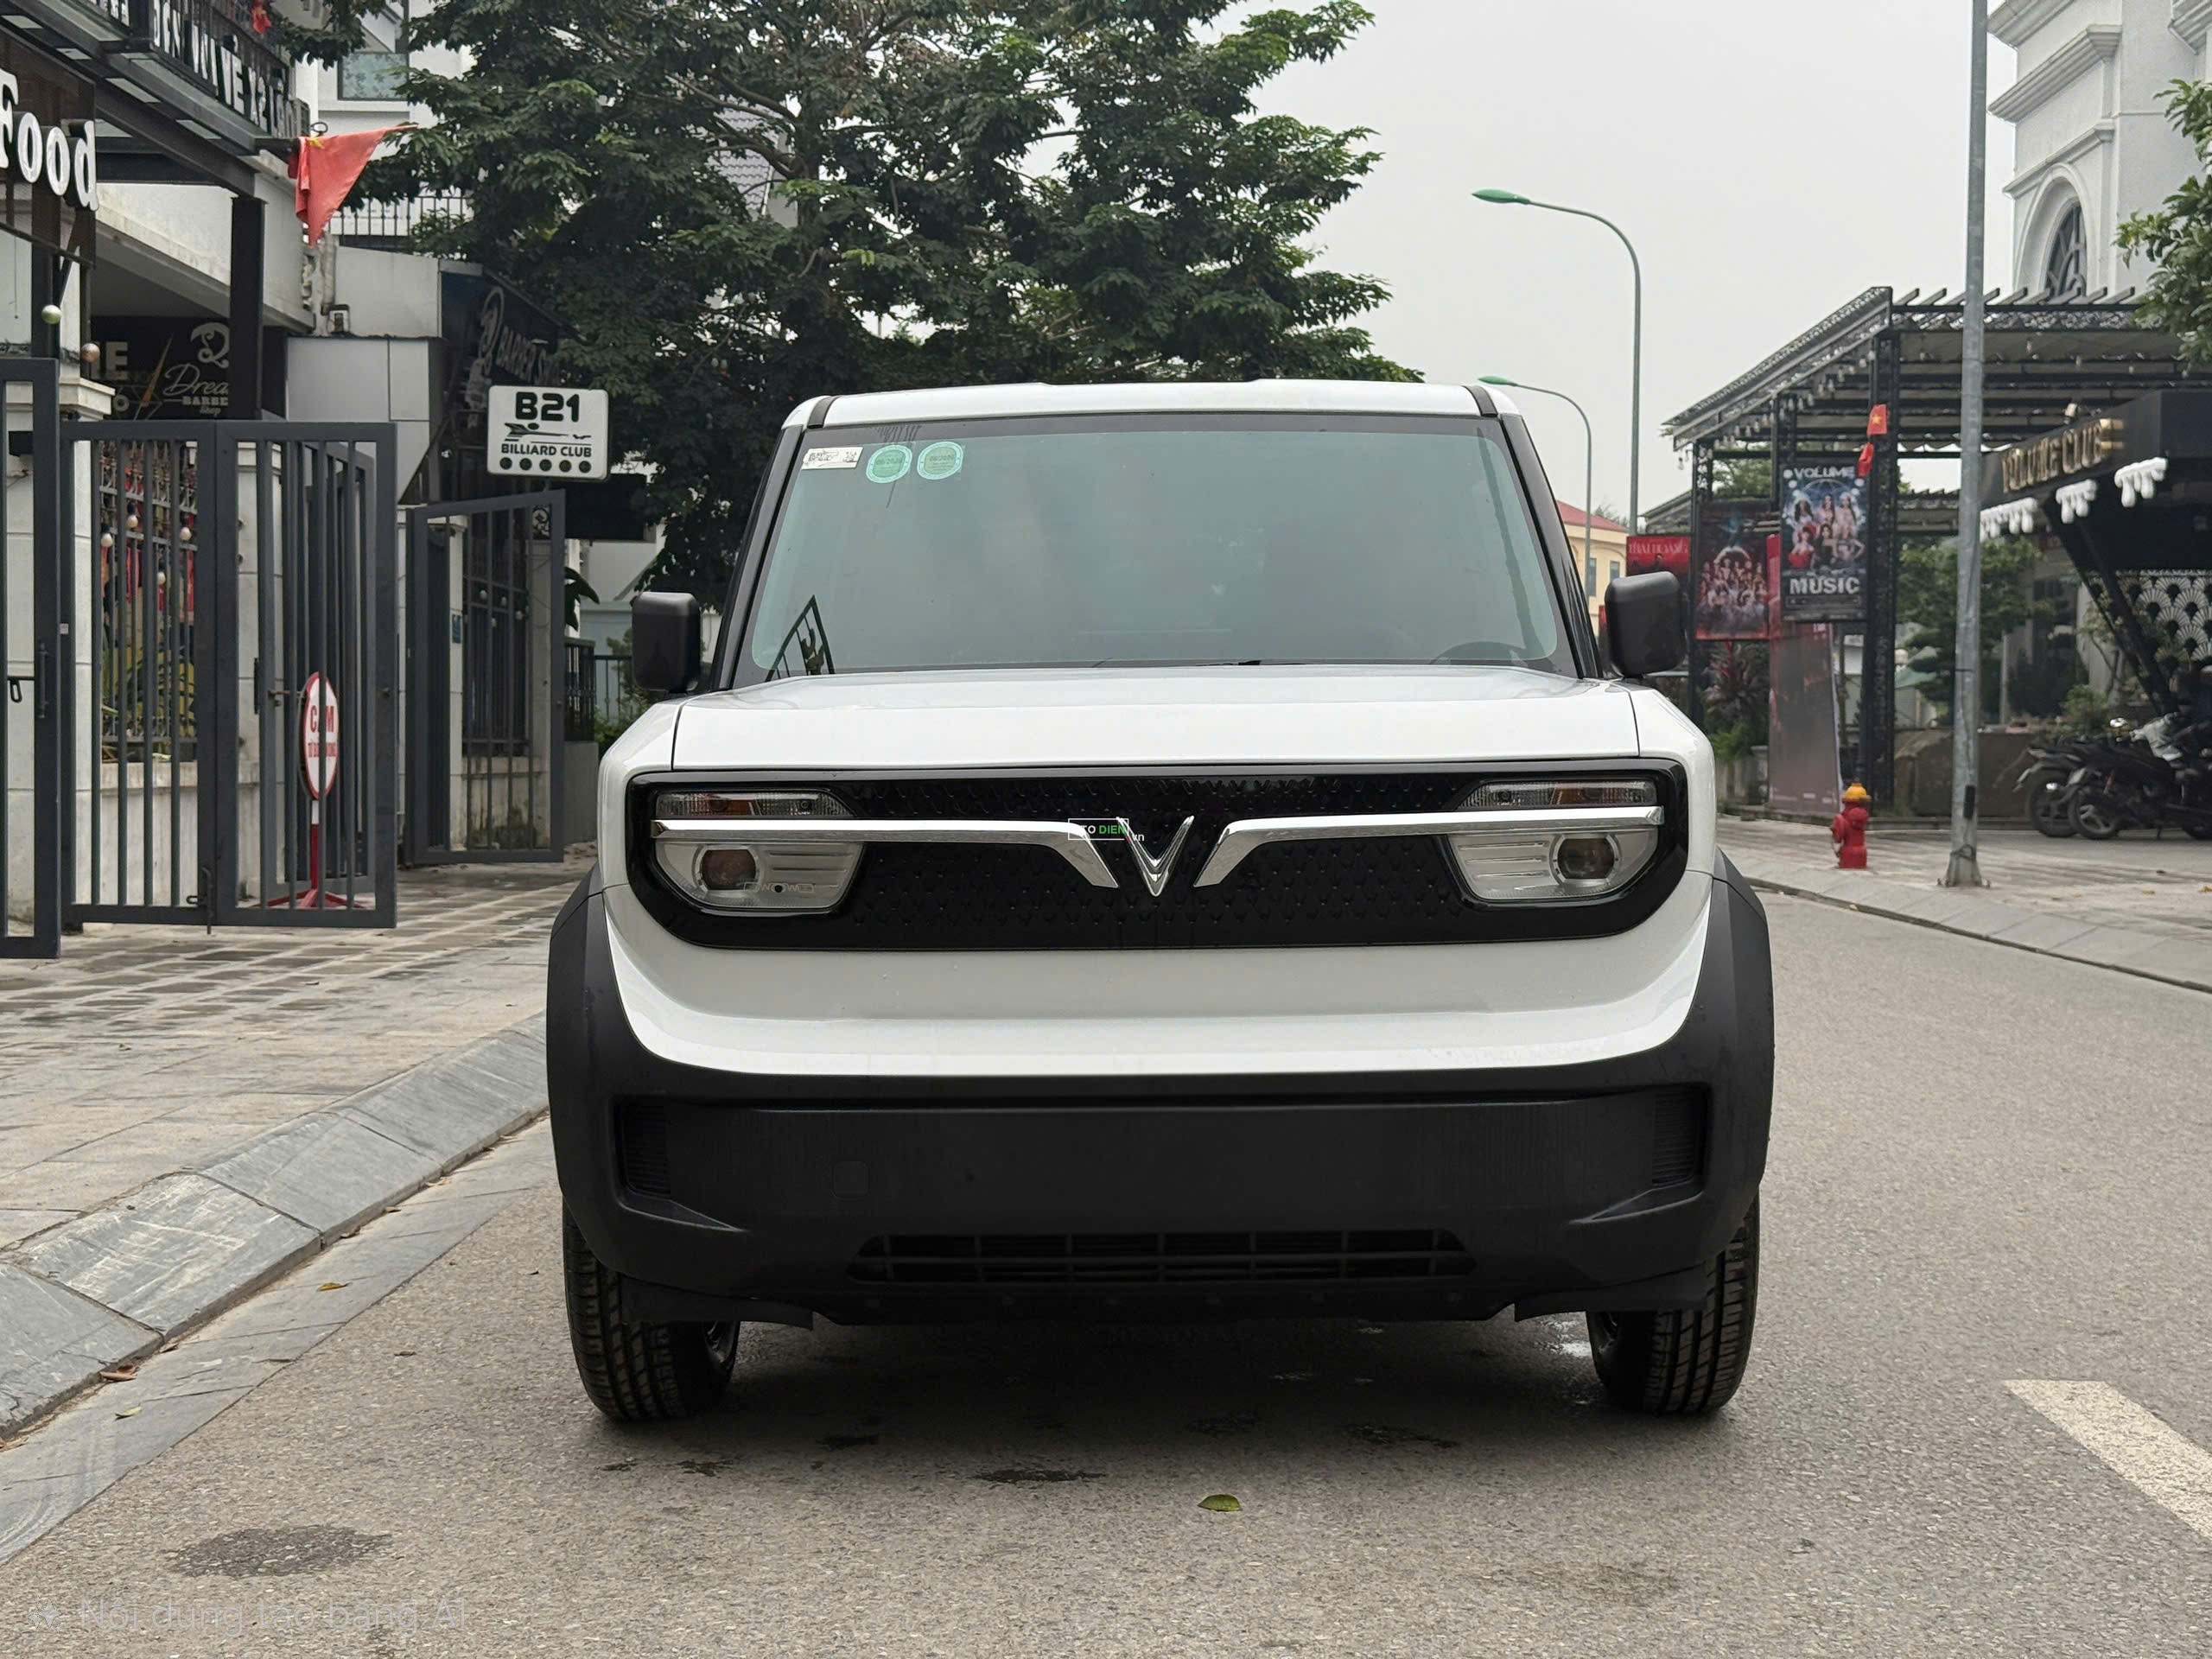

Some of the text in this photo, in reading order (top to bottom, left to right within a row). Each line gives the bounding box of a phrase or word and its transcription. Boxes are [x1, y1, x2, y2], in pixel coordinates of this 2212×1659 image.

[0, 67, 99, 212] Food
[515, 391, 580, 423] B21
[501, 443, 592, 458] BILLIARD CLUB
[1793, 466, 1855, 480] VOLUME
[1789, 575, 1860, 594] MUSIC
[309, 704, 334, 733] CM
